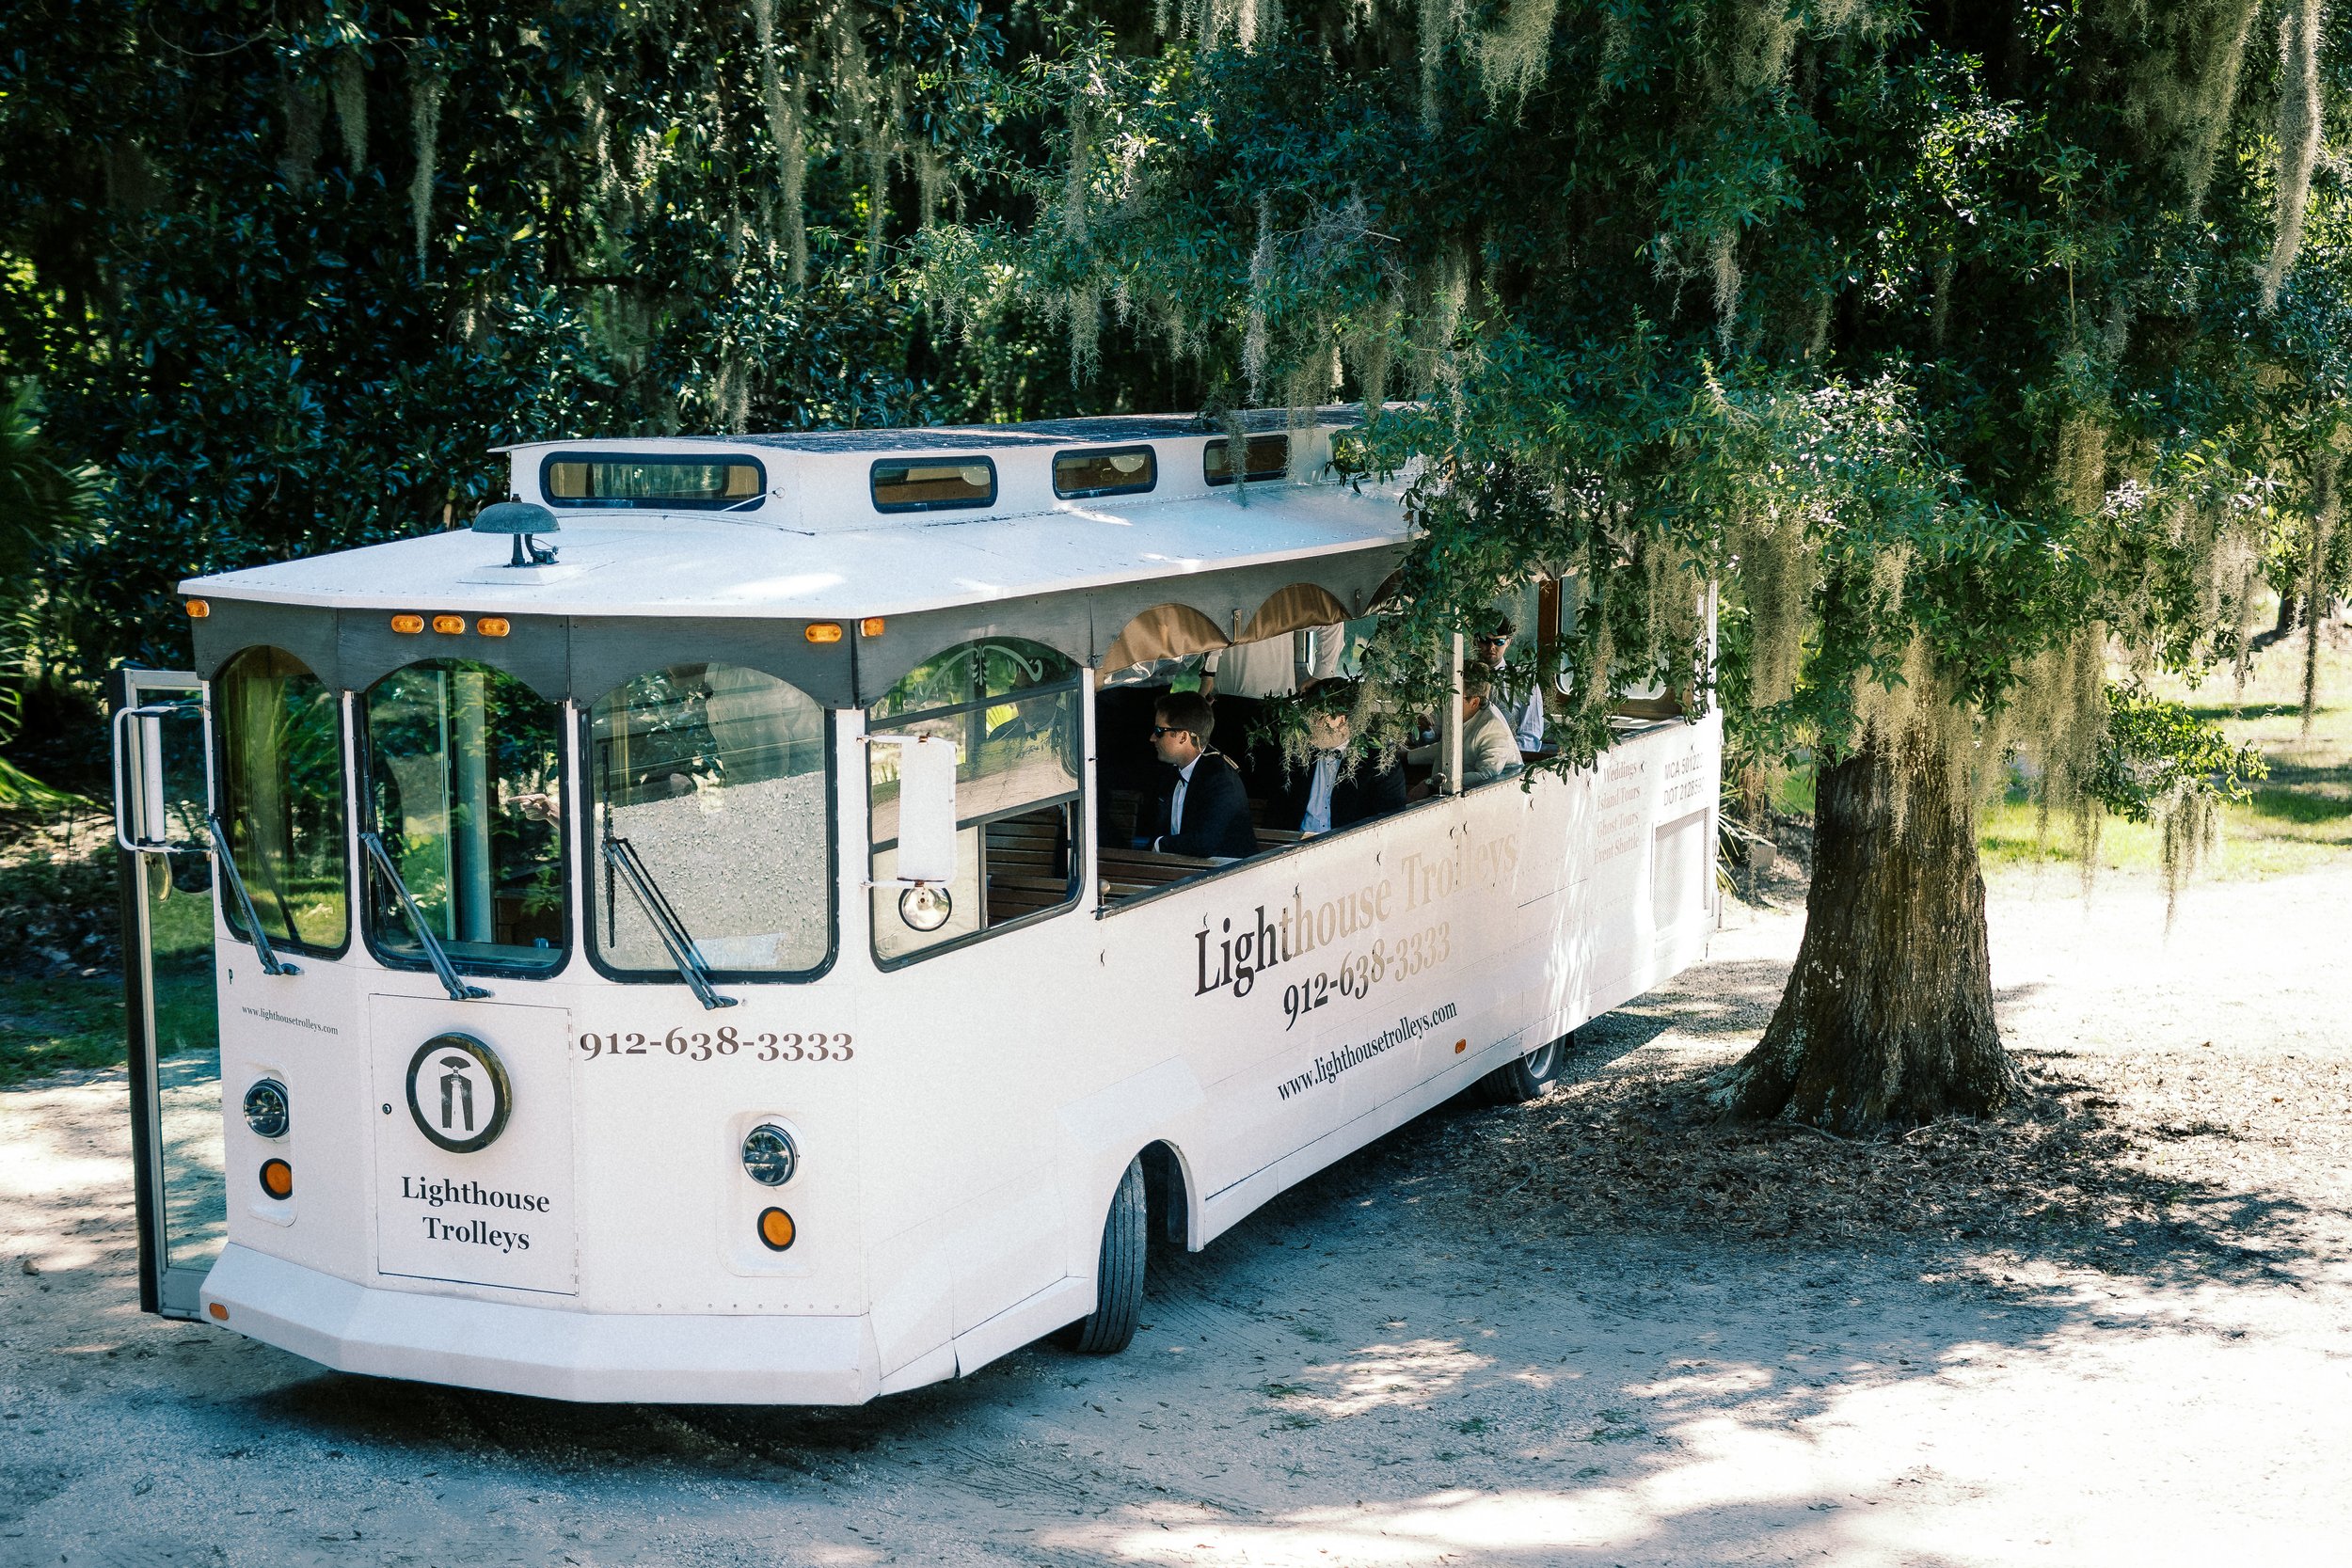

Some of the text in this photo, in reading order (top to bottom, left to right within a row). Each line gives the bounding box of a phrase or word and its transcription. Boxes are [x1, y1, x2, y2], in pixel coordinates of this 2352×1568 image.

[1603, 761, 1637, 783] Weddings
[1664, 760, 1680, 780] MCA
[1597, 786, 1640, 812] Island Tours
[1663, 785, 1678, 806] DOT
[1597, 813, 1639, 838] Ghost Tours
[1594, 832, 1640, 865] Event Shuttle
[1195, 830, 1517, 998] Lighthouse Trolleys
[1283, 921, 1451, 1032] 912-638-3333
[242, 1006, 339, 1036] www.lighthousetrolleys.com
[580, 1026, 854, 1062] 912-638-3333
[1277, 1001, 1458, 1101] www.lighthousetrolleys.com
[401, 1176, 550, 1213] Lighthouse
[422, 1216, 530, 1254] Trolleys
